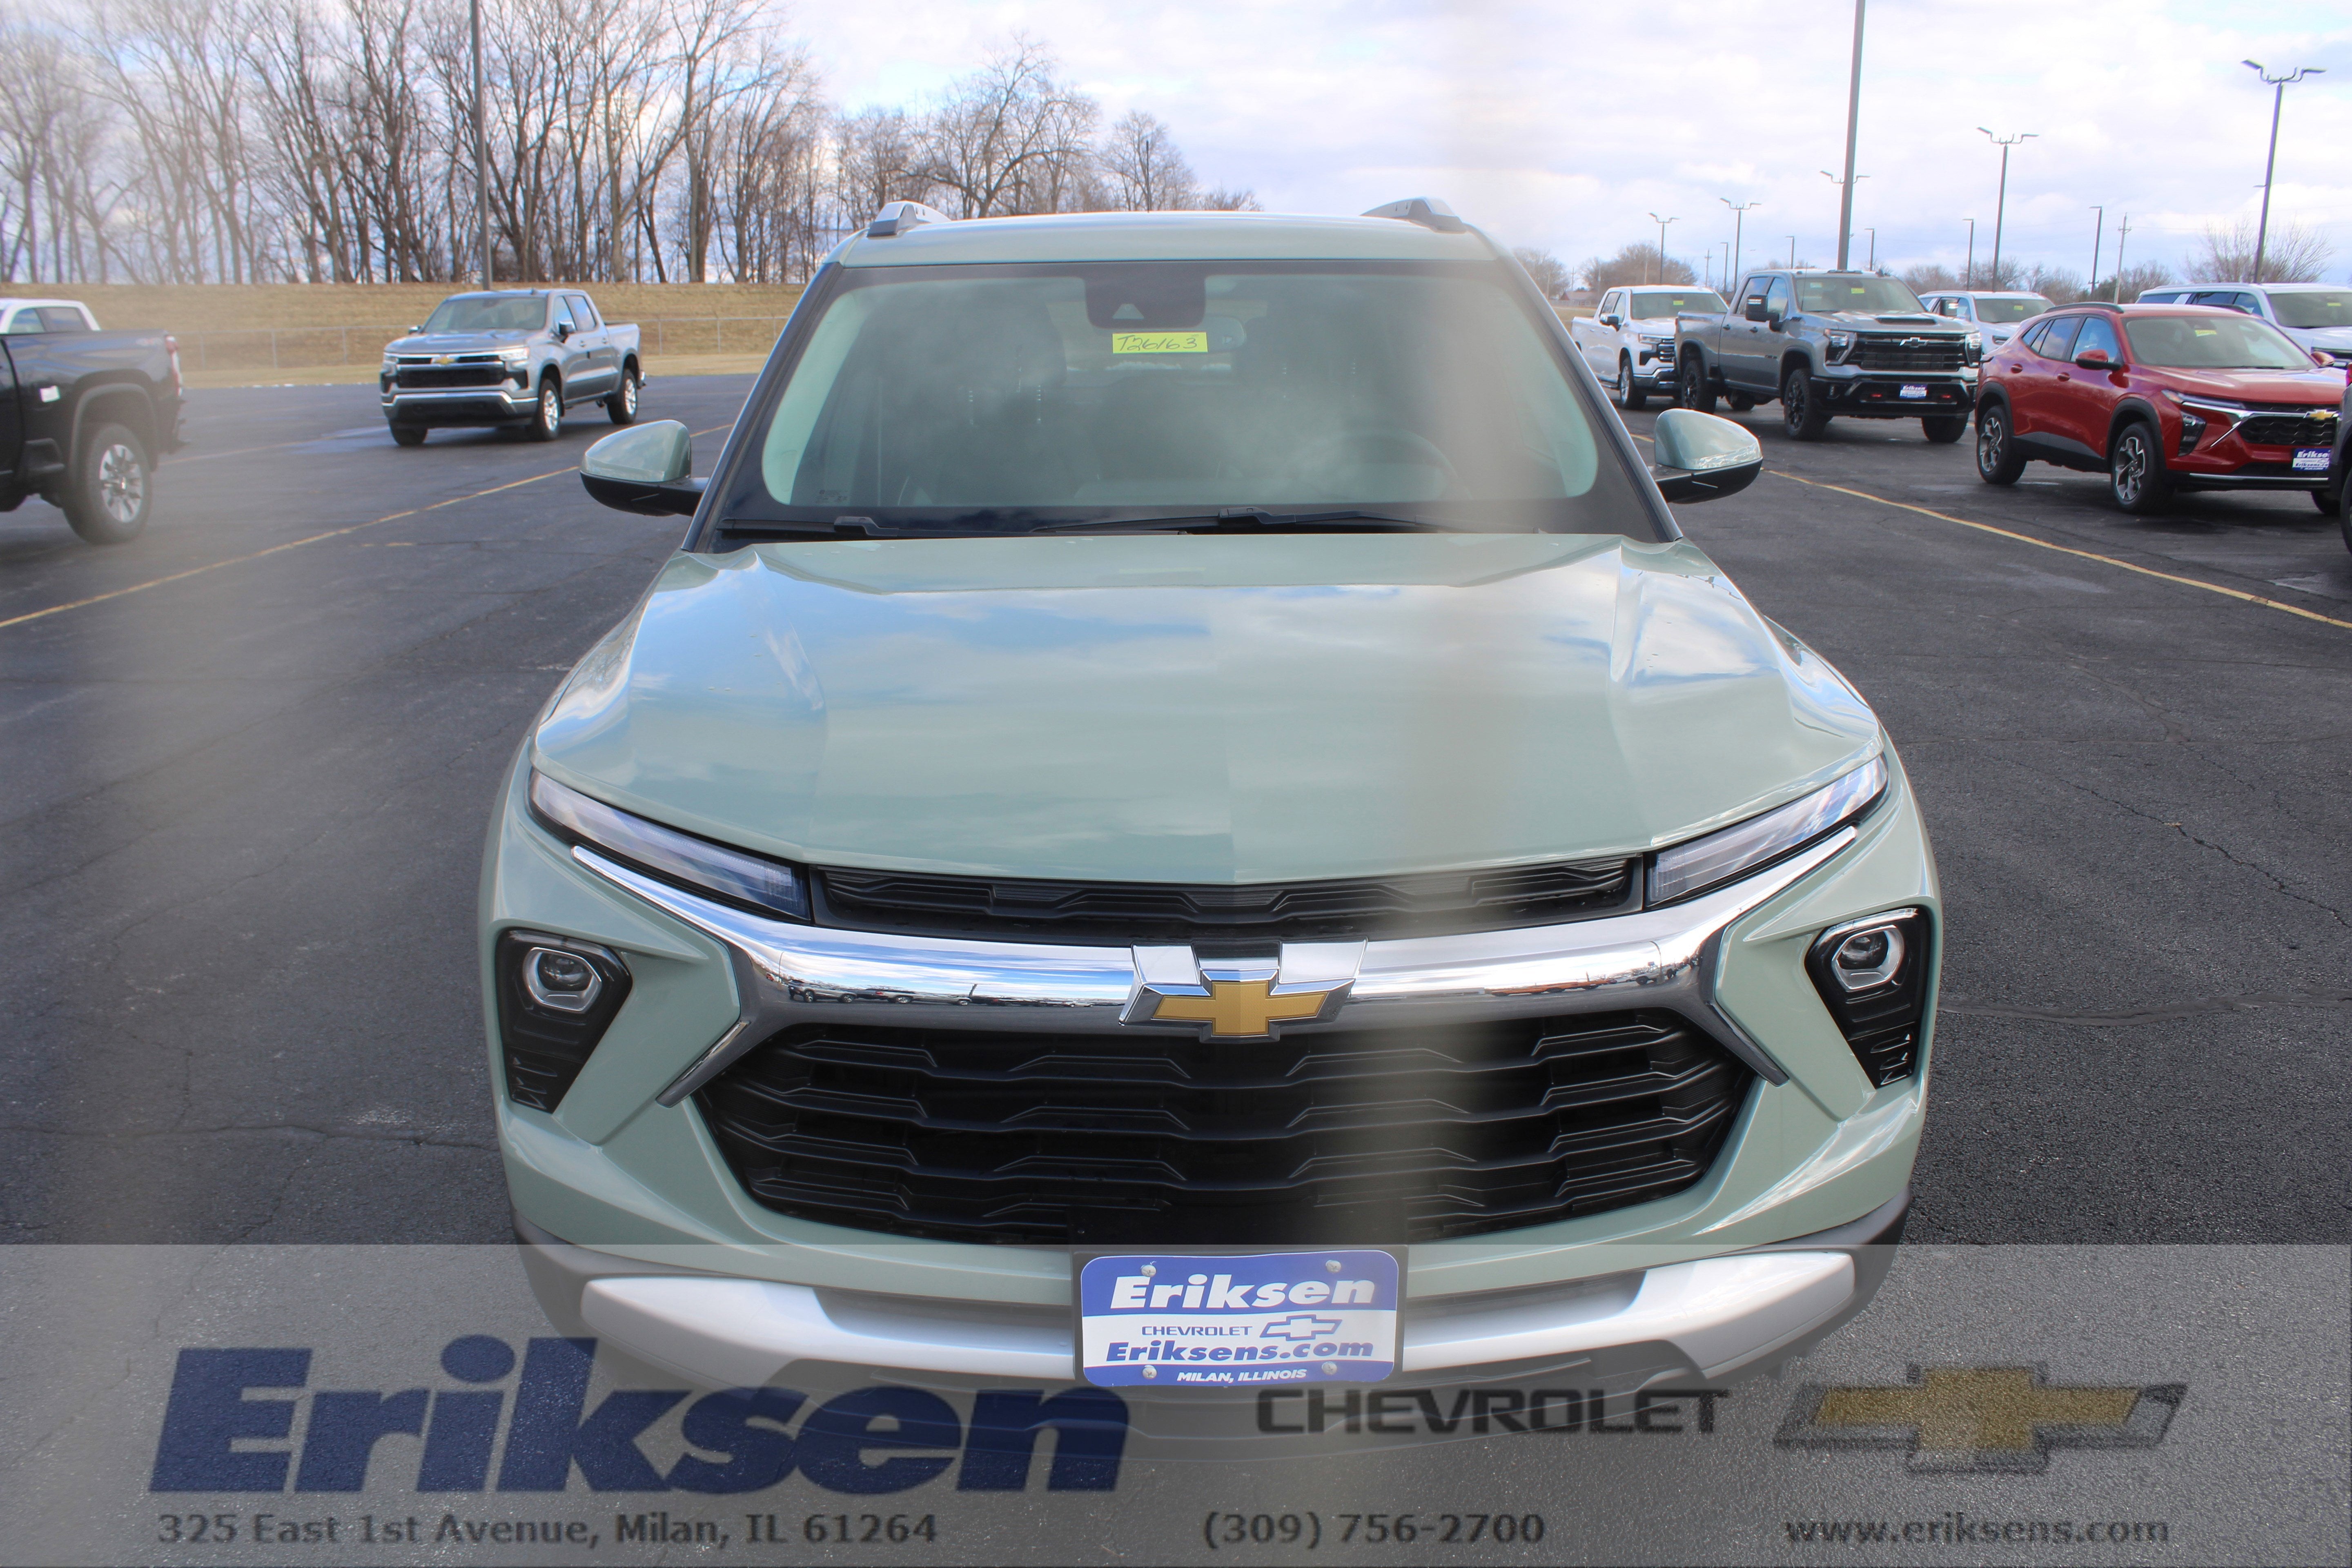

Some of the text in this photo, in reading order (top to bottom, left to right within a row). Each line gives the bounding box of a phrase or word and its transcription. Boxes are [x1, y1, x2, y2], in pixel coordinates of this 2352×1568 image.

[1117, 334, 1198, 352] T26163
[1110, 1274, 1375, 1309] Eriksen
[1142, 1325, 1253, 1336] CHEVROLET
[1106, 1340, 1374, 1361] Eriksens.com
[1176, 1368, 1307, 1383] MILAN, ILLINOIS
